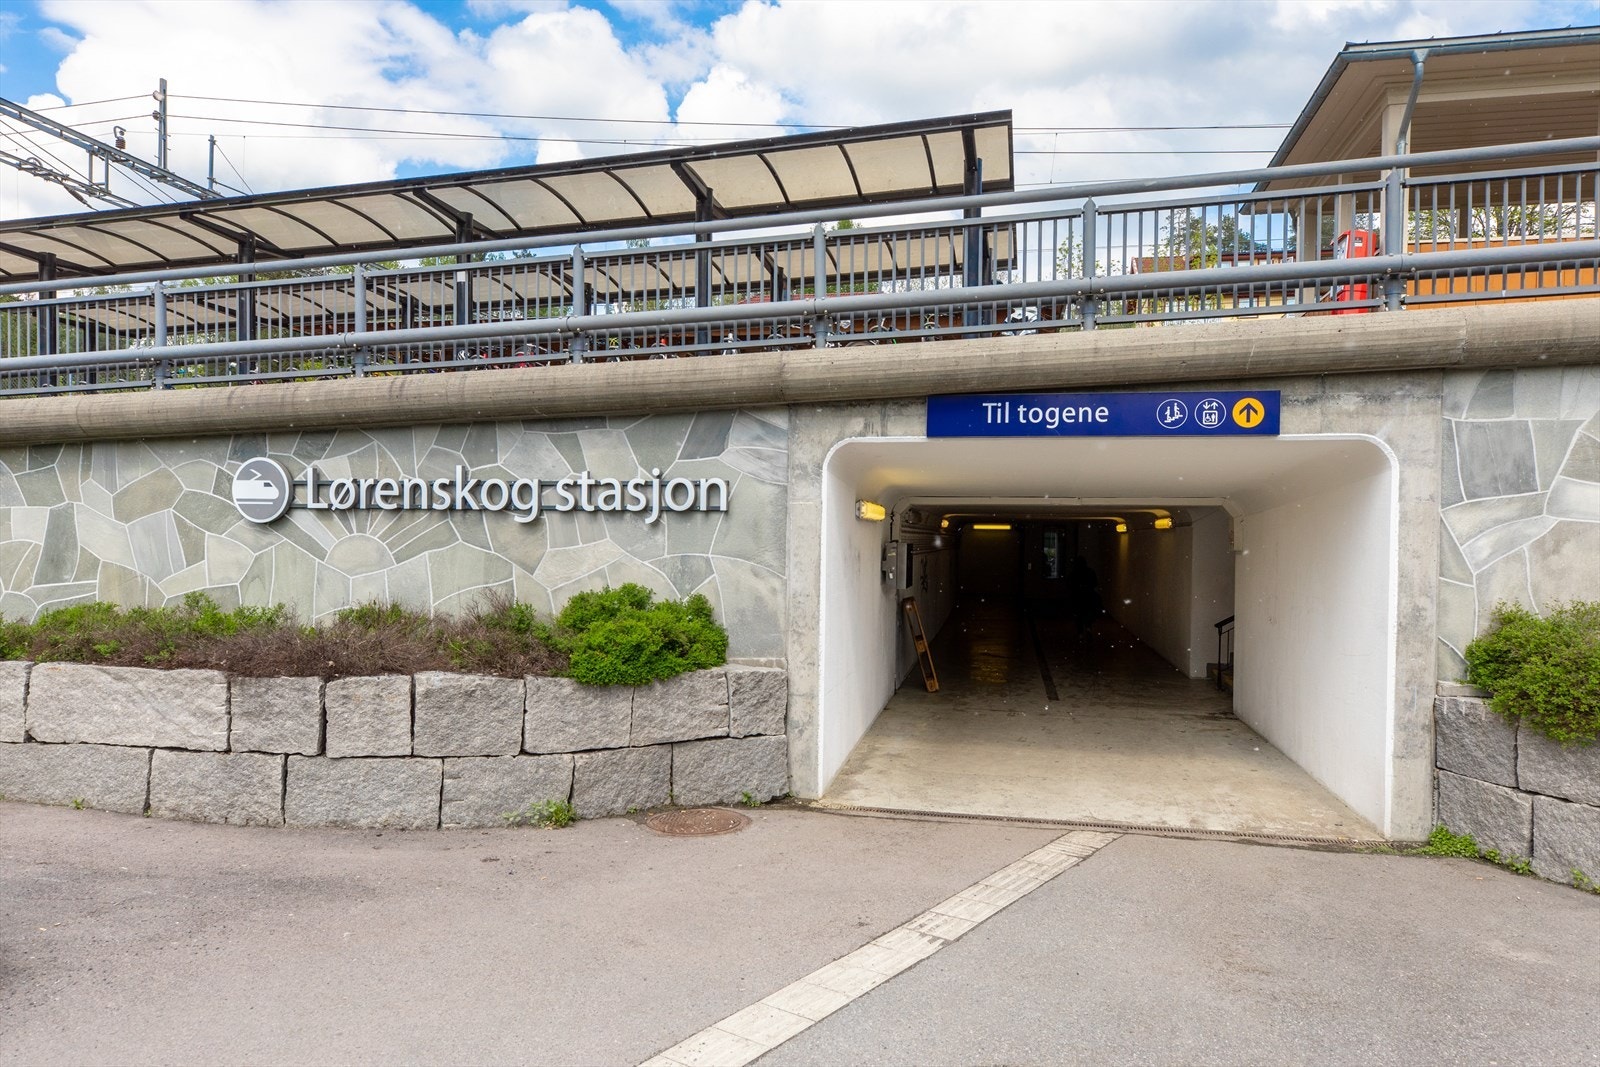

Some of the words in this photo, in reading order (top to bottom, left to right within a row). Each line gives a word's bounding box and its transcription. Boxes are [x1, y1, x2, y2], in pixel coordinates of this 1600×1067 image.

[982, 402, 1010, 424] Til
[1017, 404, 1109, 428] togene
[305, 465, 542, 523] Lørenskog
[554, 467, 728, 524] stasjon
